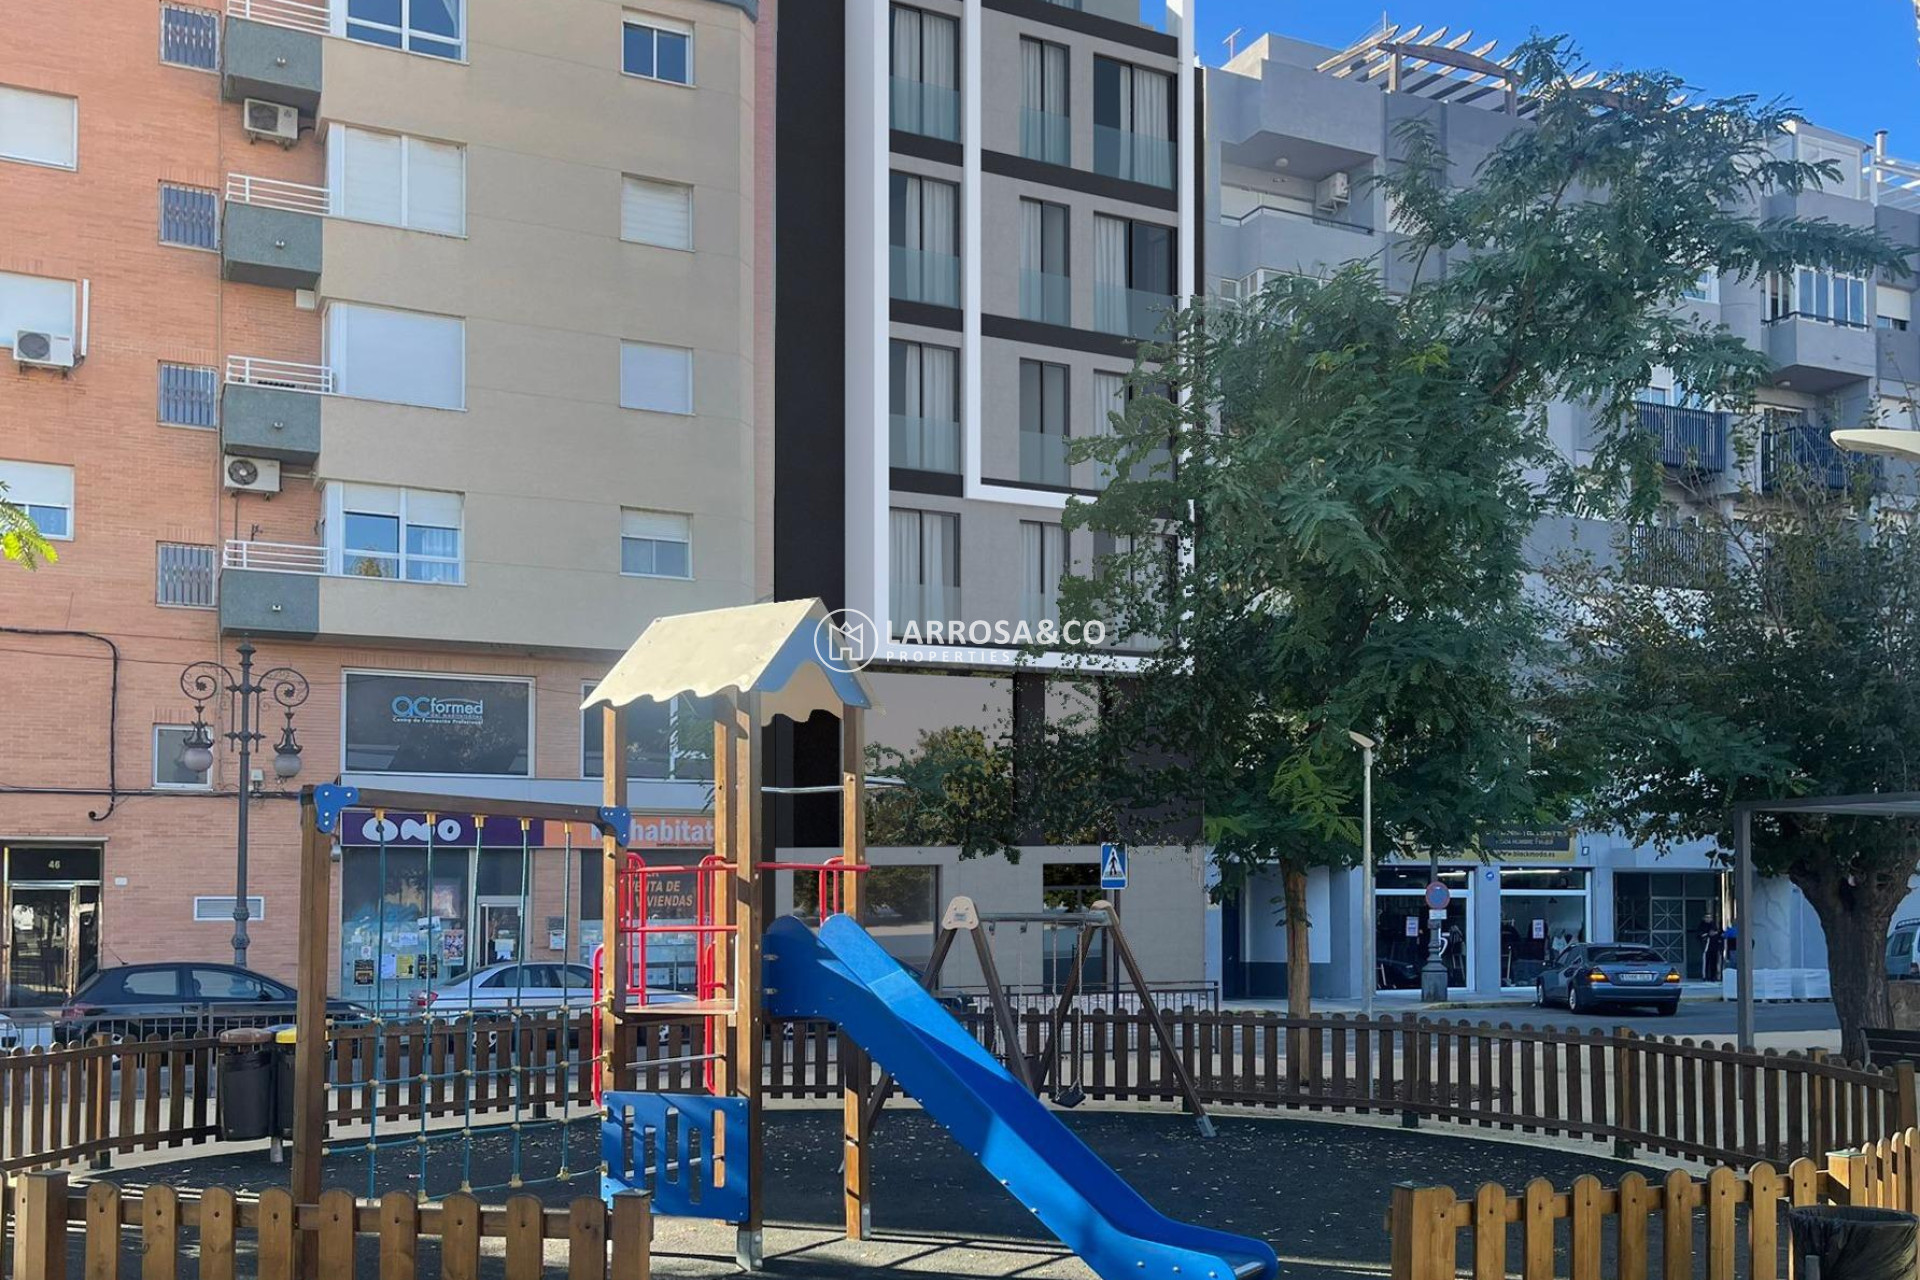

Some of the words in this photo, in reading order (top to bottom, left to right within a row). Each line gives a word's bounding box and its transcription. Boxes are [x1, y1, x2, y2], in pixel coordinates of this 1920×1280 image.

[48, 860, 61, 870] 46
[666, 880, 681, 892] DE
[635, 894, 693, 907] VVIENDAS
